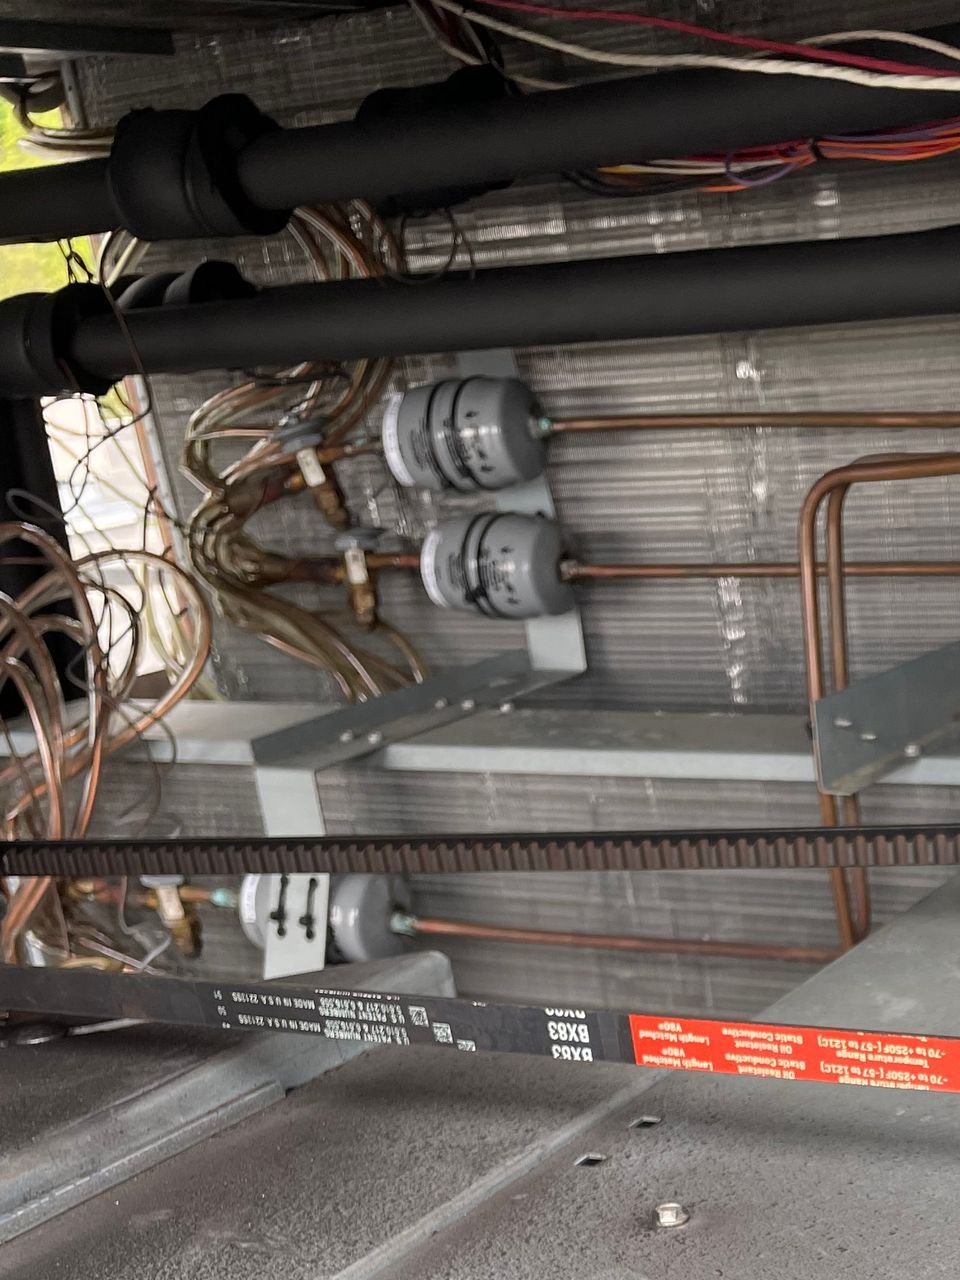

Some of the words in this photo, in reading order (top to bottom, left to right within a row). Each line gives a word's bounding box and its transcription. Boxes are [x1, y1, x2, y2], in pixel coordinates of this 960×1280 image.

[283, 997, 292, 1007] IN
[294, 998, 315, 1010] MADE
[319, 1007, 356, 1020] NUMBERS
[358, 1011, 386, 1023] PATENT
[289, 1020, 298, 1030] IN
[299, 1021, 320, 1032] MADE
[548, 1021, 590, 1043] BX83
[639, 1029, 677, 1040] Matched
[722, 1028, 773, 1042] Conductive
[679, 1033, 710, 1046] Length
[775, 1033, 803, 1044] Static
[734, 1040, 778, 1052] Resistant
[780, 1044, 792, 1054] Oil
[848, 1040, 858, 1049] to
[884, 1044, 914, 1055] +250F
[836, 1050, 866, 1062] Range
[916, 1047, 926, 1056] to
[928, 1048, 946, 1058] -70
[642, 1054, 681, 1066] Matched
[682, 1058, 713, 1071] Length
[724, 1053, 776, 1067] Conductive
[778, 1059, 806, 1070] Static
[867, 1053, 929, 1068] Temperature
[738, 1065, 781, 1078] Resistant
[782, 1070, 795, 1080] Oil
[850, 1066, 860, 1076] to
[886, 1070, 916, 1081] +250F
[918, 1073, 928, 1082] to
[930, 1075, 948, 1085] -70
